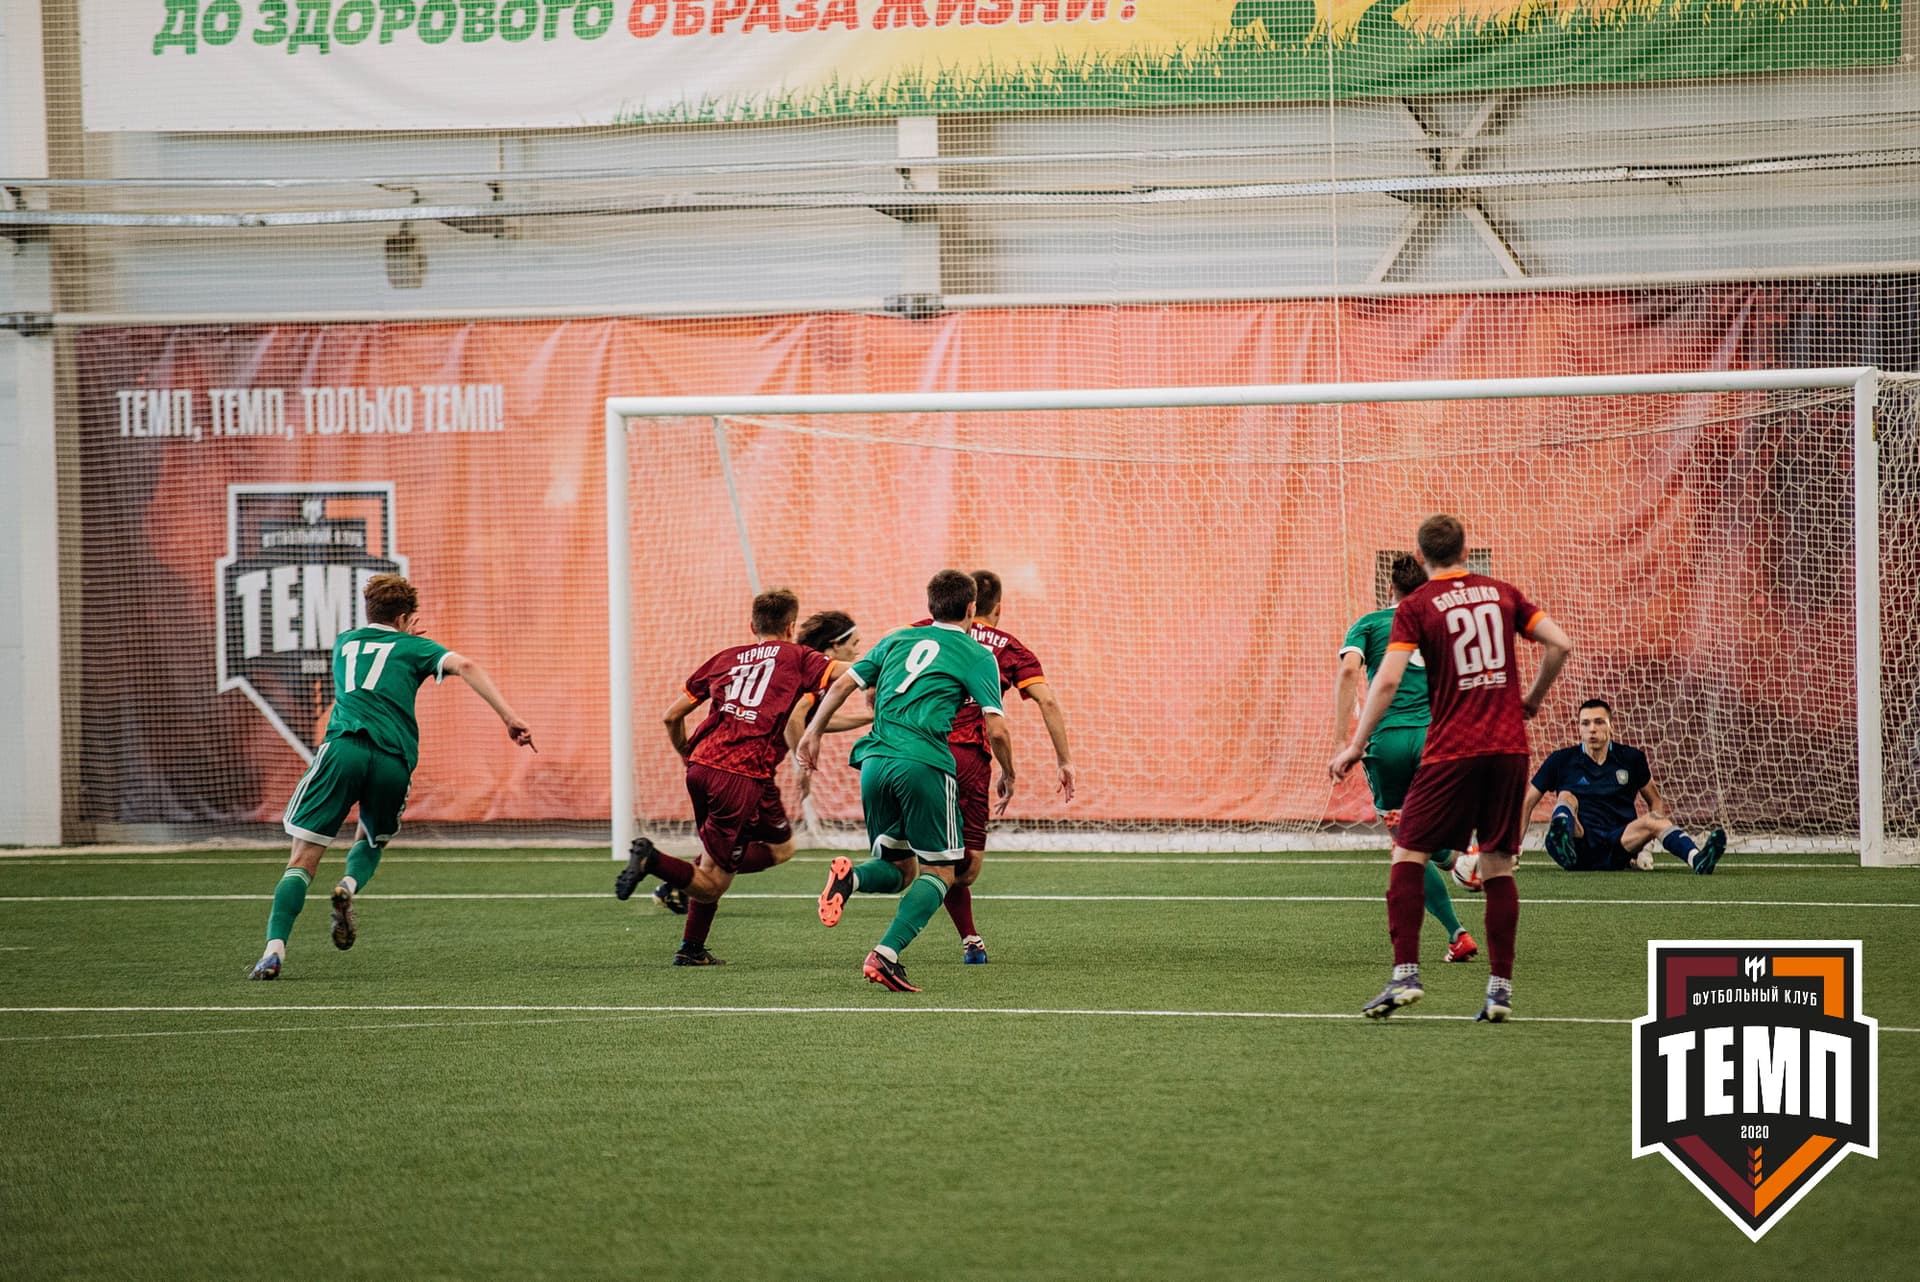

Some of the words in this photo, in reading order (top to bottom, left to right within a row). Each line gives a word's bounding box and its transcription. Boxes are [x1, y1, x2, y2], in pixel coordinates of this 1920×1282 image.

[153, 0, 243, 55] ДО
[252, 0, 614, 54] ЗДОРОВОГО
[627, 0, 859, 38] ОБРАЗА
[117, 388, 201, 442] ТЕМП,
[208, 386, 295, 441] ТЕМП,
[302, 385, 413, 435] ТОЛЬКО
[420, 383, 505, 433] ТЕМП!
[341, 641, 396, 692] 17
[736, 645, 780, 664] ЧЕРНОВ
[894, 638, 941, 694] 9
[1446, 602, 1506, 676] 20
[725, 657, 776, 707] 30
